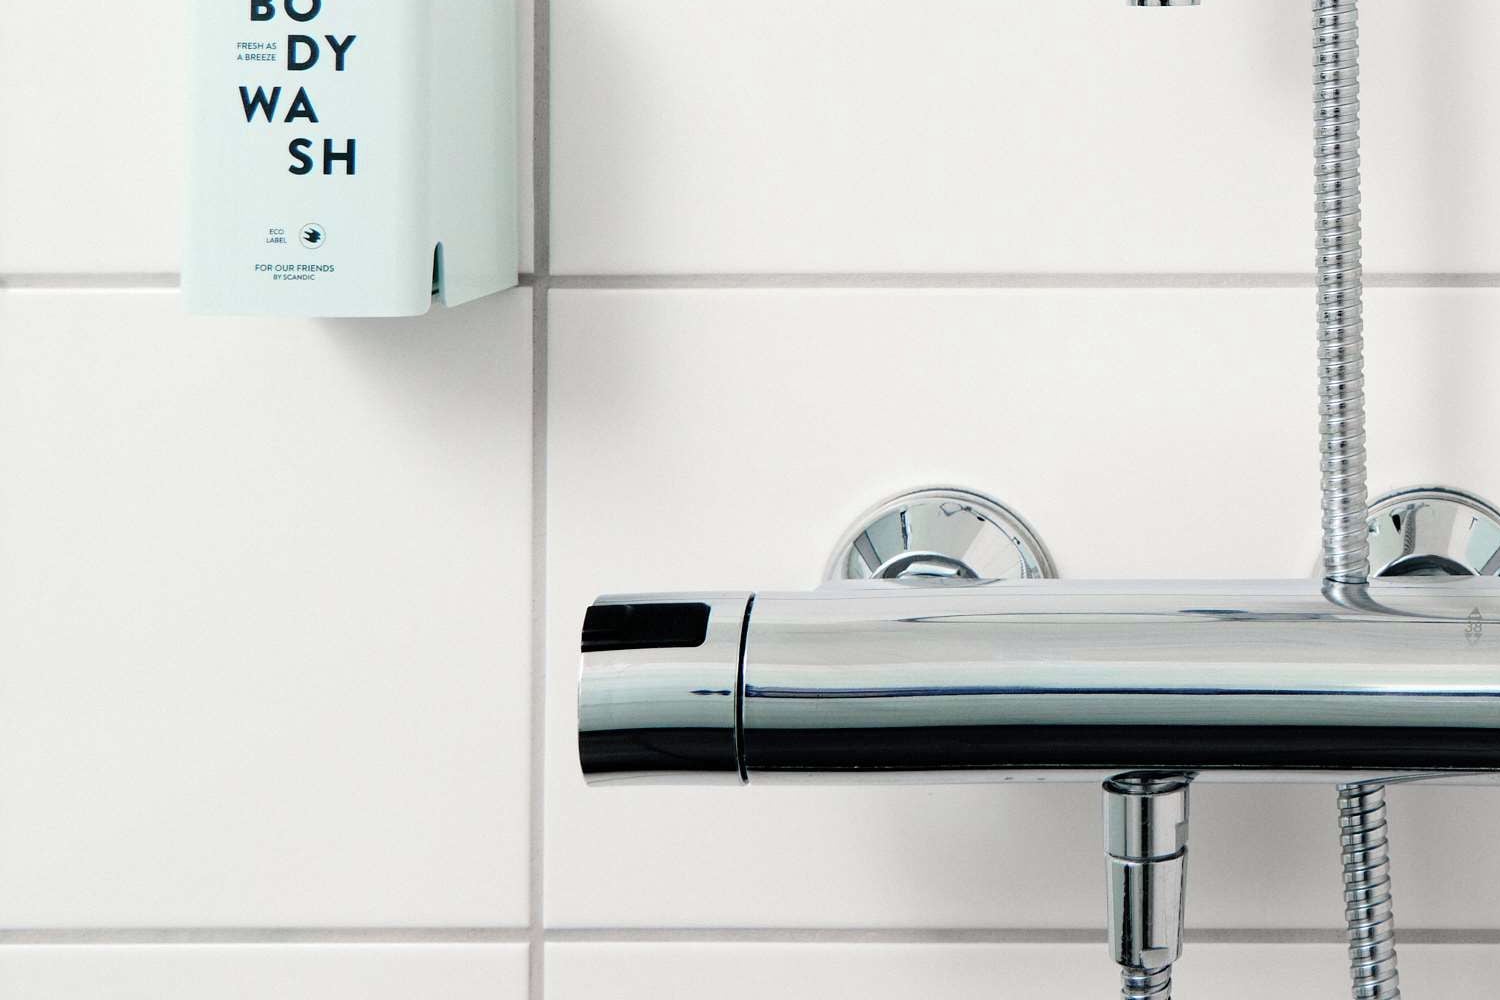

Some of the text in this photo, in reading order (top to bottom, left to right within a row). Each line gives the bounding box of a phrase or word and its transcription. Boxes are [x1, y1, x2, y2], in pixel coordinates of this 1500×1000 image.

[237, 42, 277, 50] FRESH AS
[237, 53, 277, 61] A BREEZE
[287, 35, 357, 71] DY
[238, 86, 319, 123] WA
[288, 138, 356, 175] SH
[255, 264, 335, 272] FOR OUR FRIENDS
